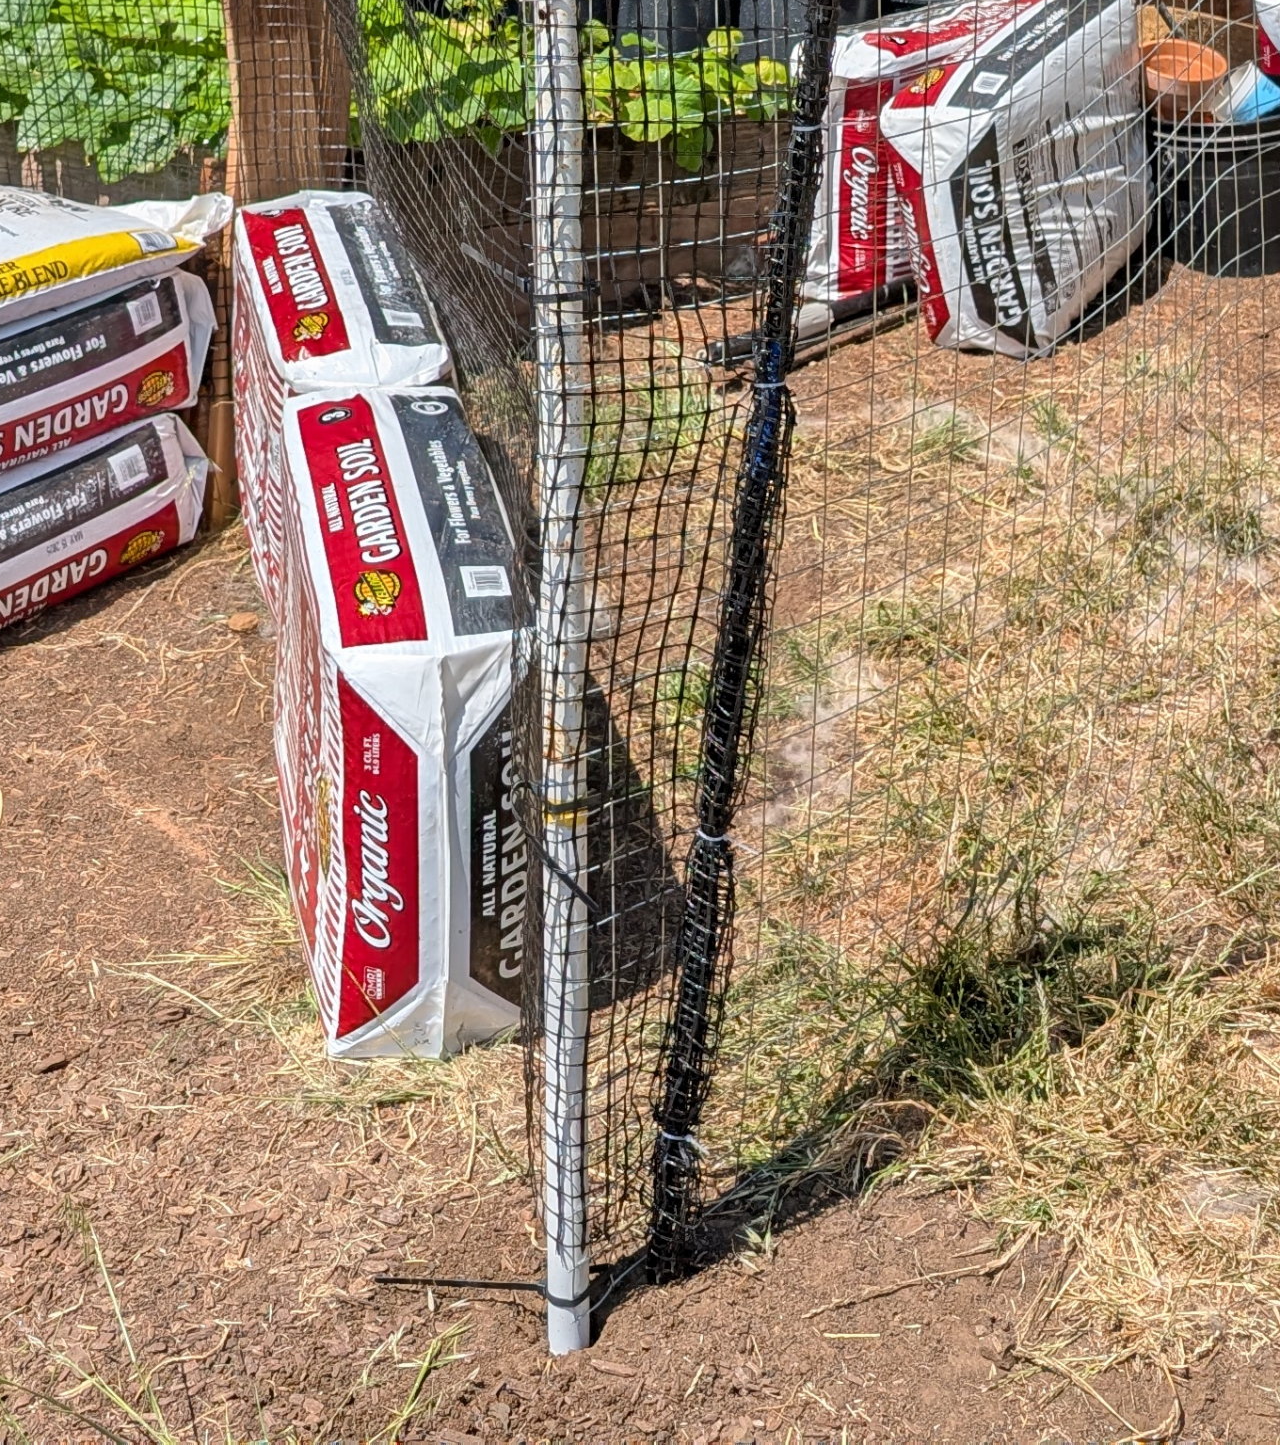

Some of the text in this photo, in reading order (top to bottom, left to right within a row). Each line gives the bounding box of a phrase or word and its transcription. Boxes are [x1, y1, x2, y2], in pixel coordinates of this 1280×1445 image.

[843, 147, 879, 240] Organic
[273, 224, 310, 255] SOIL
[969, 160, 1022, 327] GARDEN SOIL
[13, 260, 69, 294] BLEND
[282, 252, 329, 311] GARDEN
[30, 344, 84, 372] Flowers
[47, 336, 66, 348] Para
[86, 334, 106, 354] For
[18, 365, 28, 377] &
[14, 384, 128, 452] GARDEN
[322, 410, 346, 421] 3
[53, 436, 72, 451] ALL
[428, 440, 454, 484] Vegetables
[28, 495, 45, 508] Para
[67, 491, 88, 512] For
[321, 482, 344, 533] ALL NATURAL
[337, 438, 402, 563] GARDEN SOIL
[447, 494, 467, 528] Flowers
[11, 502, 64, 537] Flowers
[454, 530, 472, 545] For
[351, 789, 405, 948] Organic
[482, 809, 496, 917] ALL NATURAL
[499, 821, 528, 979] GARDEN
